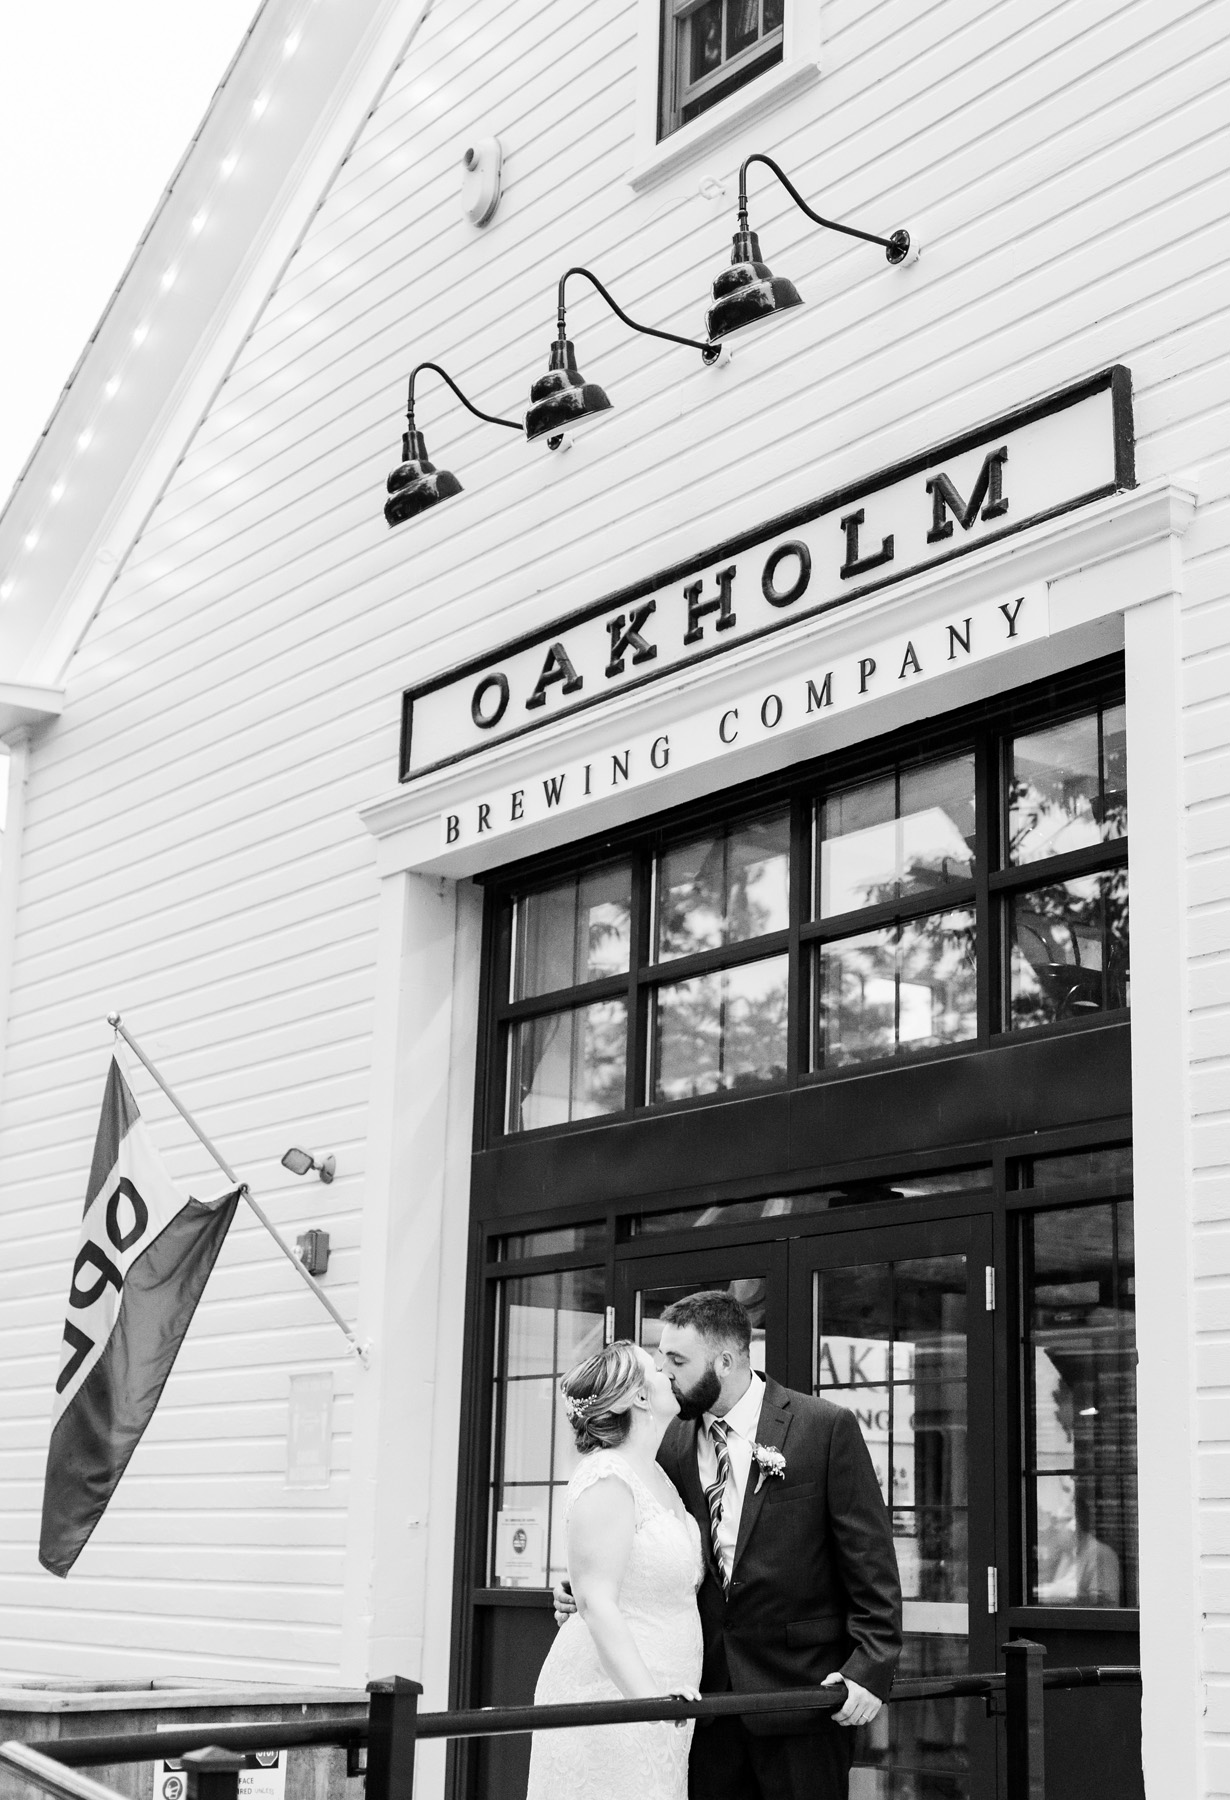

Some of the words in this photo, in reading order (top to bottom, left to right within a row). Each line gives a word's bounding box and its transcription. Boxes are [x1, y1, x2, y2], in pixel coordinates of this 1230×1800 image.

[471, 445, 1008, 729] OAKHOLM
[445, 735, 671, 844] BREWING
[718, 597, 1025, 744] COMPANY
